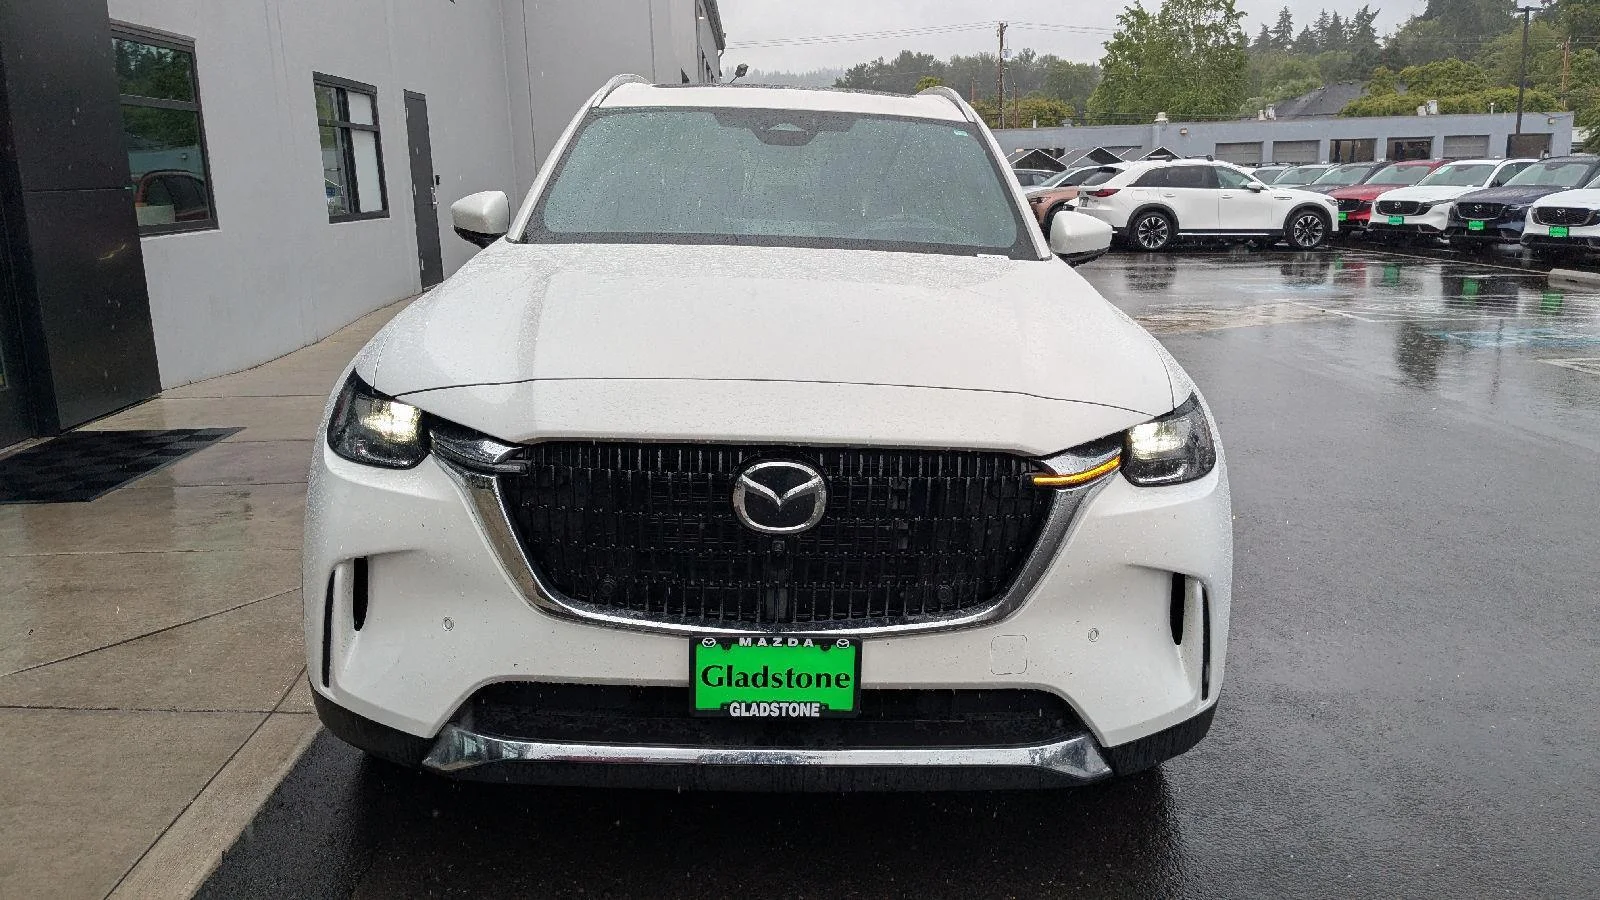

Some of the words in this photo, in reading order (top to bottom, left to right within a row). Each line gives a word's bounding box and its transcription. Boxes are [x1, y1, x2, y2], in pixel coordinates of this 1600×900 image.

[738, 638, 814, 648] MAZDA
[701, 664, 851, 689] Gladstone
[729, 702, 820, 717] GLADSTONE
